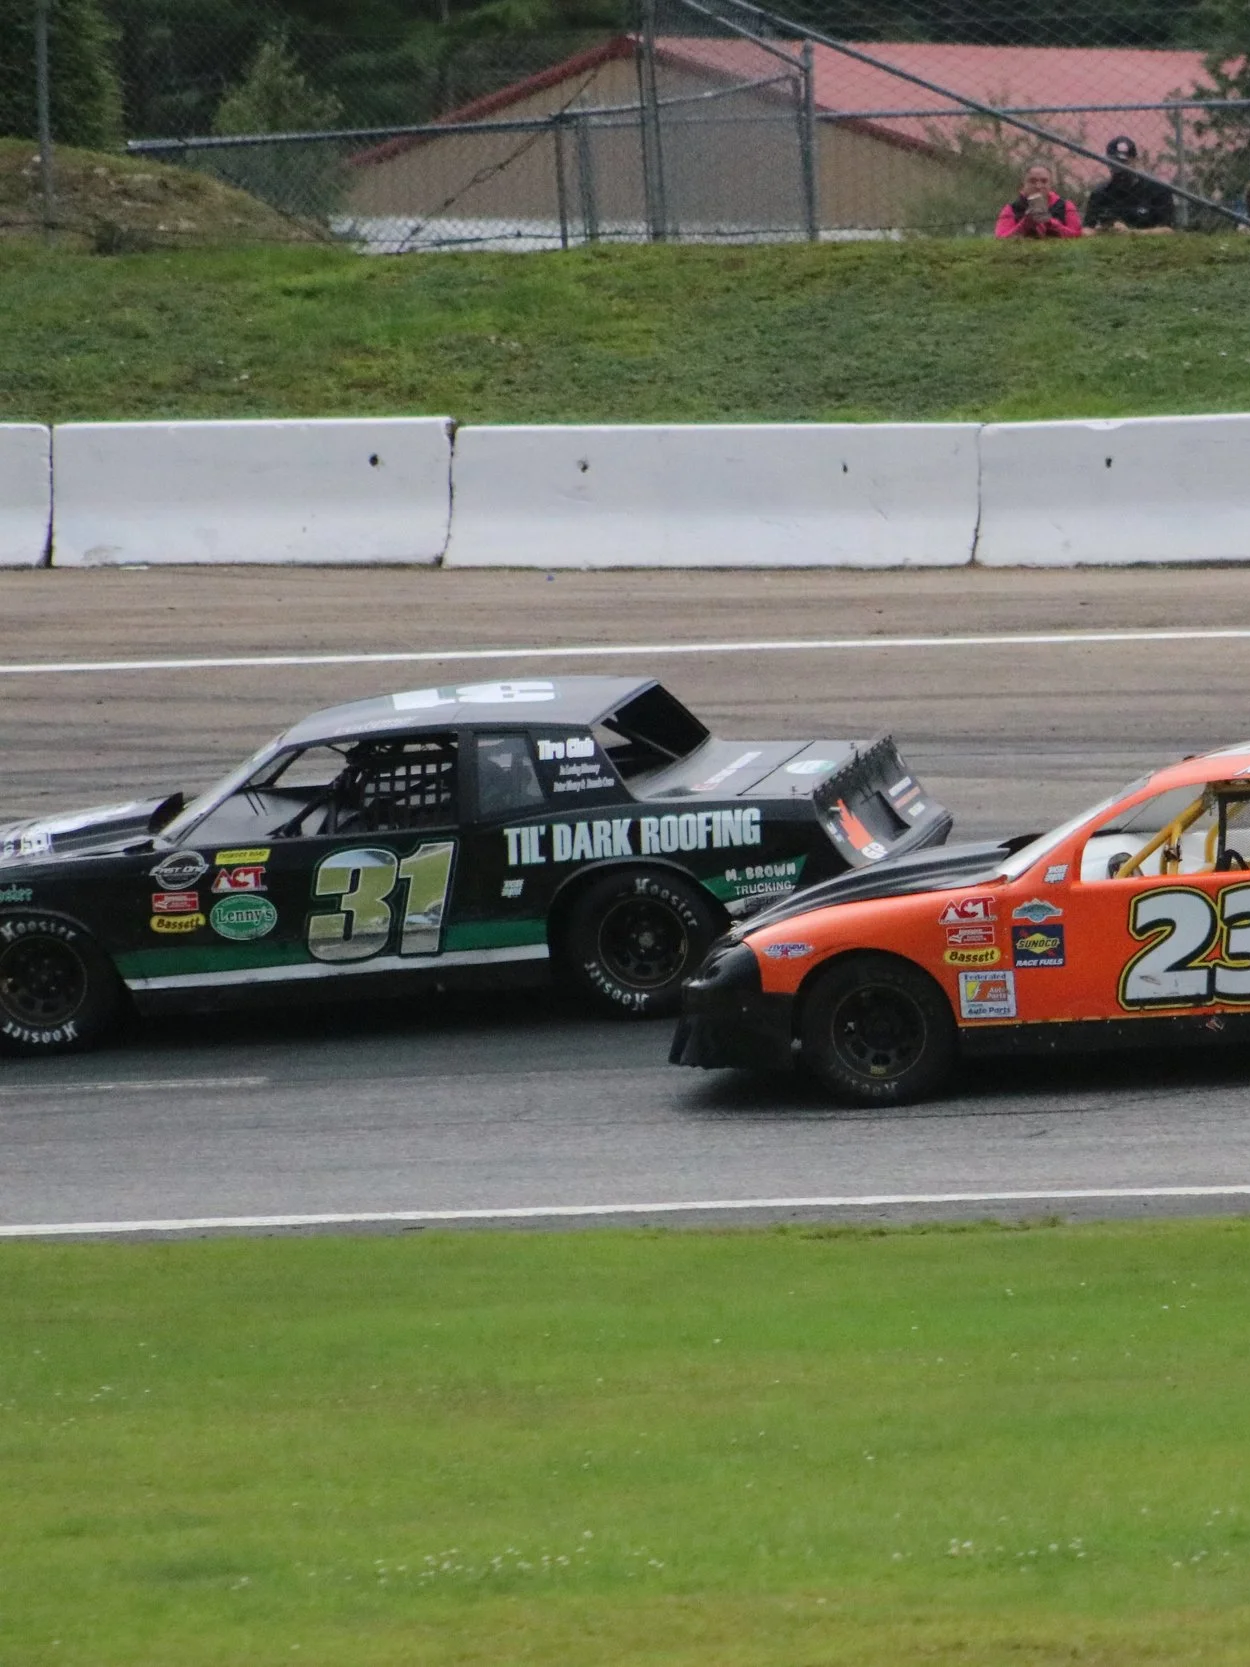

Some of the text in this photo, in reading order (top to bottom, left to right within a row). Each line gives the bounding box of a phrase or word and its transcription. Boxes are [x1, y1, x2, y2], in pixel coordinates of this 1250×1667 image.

[504, 808, 762, 867] TIL' DARK ROOFING
[211, 866, 267, 890] ACT
[725, 862, 797, 883] M. BROWN
[308, 841, 457, 961] 31
[634, 877, 698, 927] Hoosier
[940, 896, 996, 921] ACT
[156, 916, 200, 930] Bassett
[216, 906, 274, 926] Lenny's
[1018, 938, 1060, 949] SUNOCO
[949, 949, 995, 963] Bassett
[1016, 958, 1063, 967] RACE FUELS
[964, 973, 1006, 981] Federated
[989, 1006, 1011, 1015] Parts
